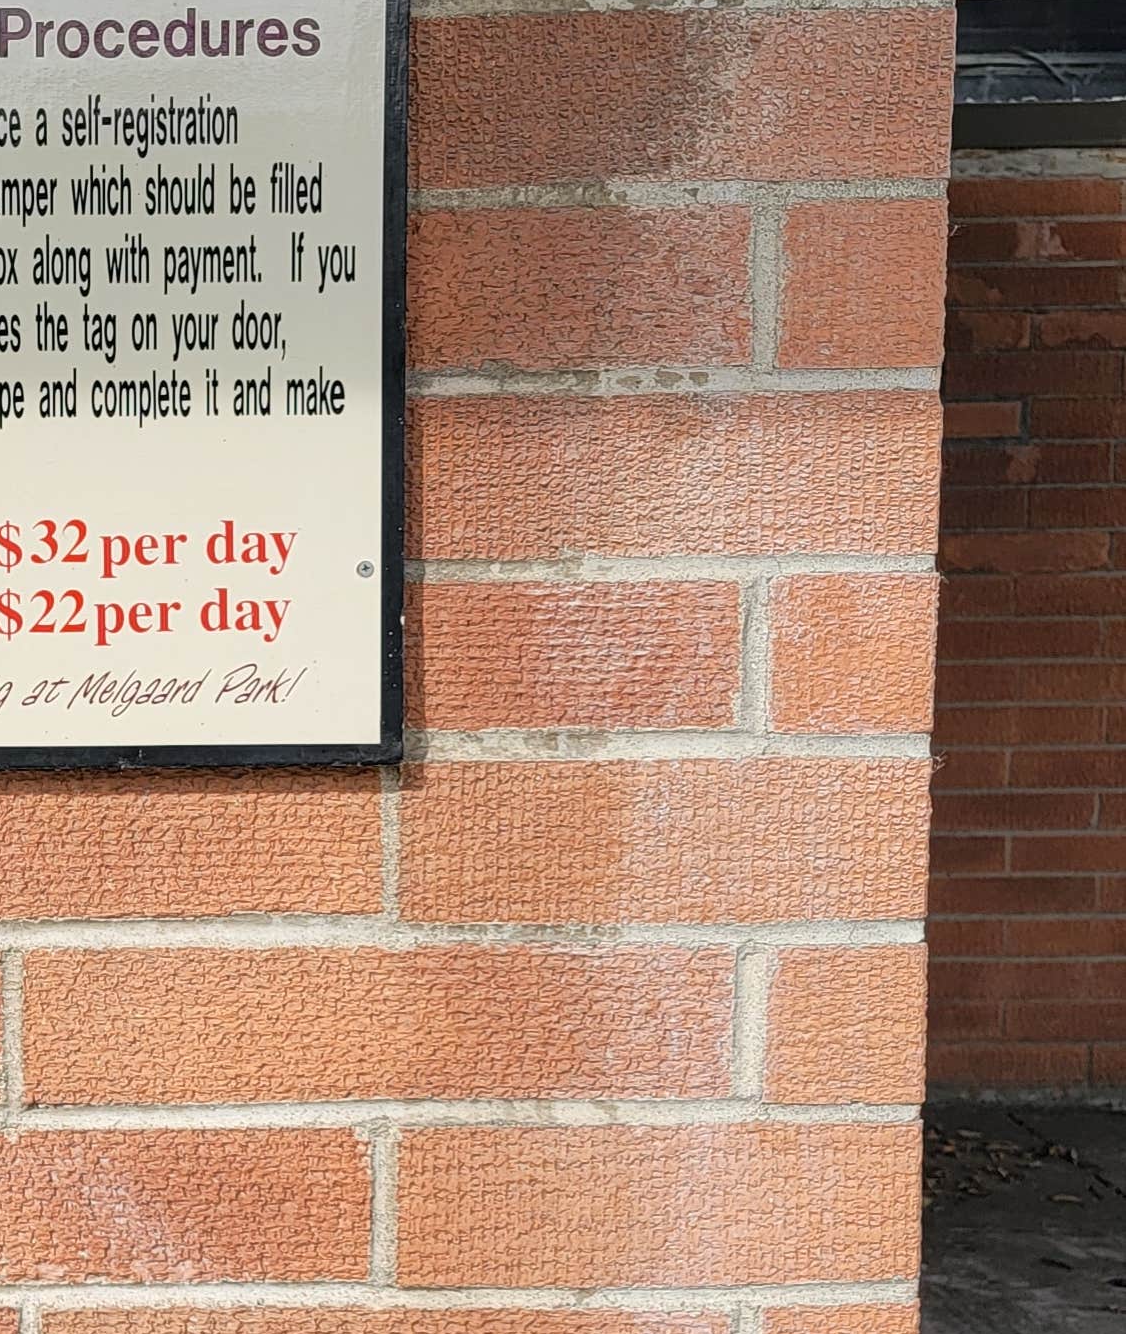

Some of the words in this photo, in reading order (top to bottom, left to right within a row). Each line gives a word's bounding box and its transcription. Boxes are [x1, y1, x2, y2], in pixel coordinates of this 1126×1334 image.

[35, 107, 48, 147] a
[61, 92, 238, 159] self-registration
[70, 163, 132, 217] which
[144, 162, 215, 216] should
[229, 162, 257, 216] be
[269, 161, 323, 215] filled
[32, 233, 92, 298] along
[105, 232, 150, 284] with
[163, 234, 262, 296] payment.
[290, 231, 305, 283] If
[317, 243, 356, 294] you
[35, 300, 69, 353] the
[82, 302, 117, 365] tag
[131, 312, 158, 352] on
[171, 312, 219, 362] your
[231, 298, 287, 361] door,
[38, 367, 78, 419] and
[90, 368, 192, 429] complete
[205, 367, 219, 417] it
[232, 365, 272, 417] and
[286, 365, 346, 417] make
[99, 533, 188, 579] per
[206, 519, 298, 576] day
[93, 601, 182, 647] per
[199, 587, 292, 643] day
[22, 678, 70, 706] at
[67, 669, 211, 717] Melgaard
[215, 664, 307, 704] Park!
